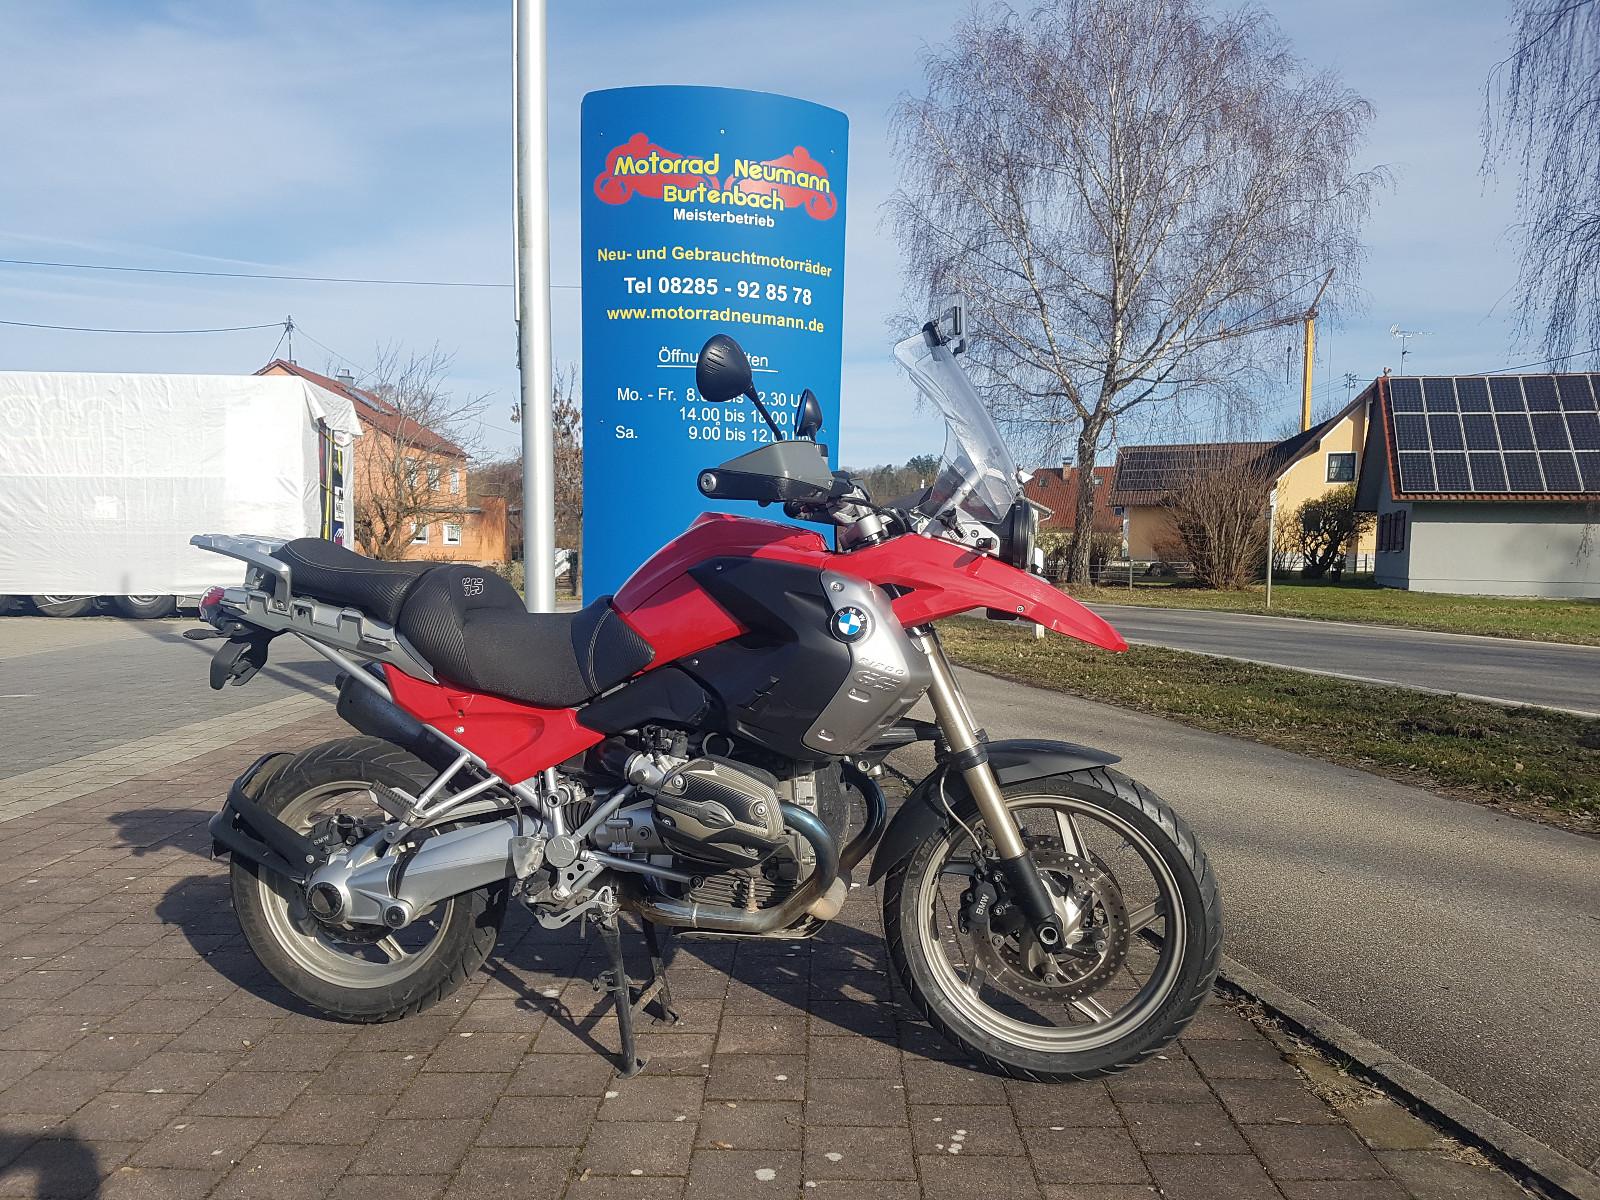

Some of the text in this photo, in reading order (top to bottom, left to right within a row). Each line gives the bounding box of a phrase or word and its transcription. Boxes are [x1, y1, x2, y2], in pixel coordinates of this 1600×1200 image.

[613, 151, 831, 194] Motorrad Neumann
[662, 183, 785, 211] Burtenbach
[672, 207, 775, 228] Meisterbetrieb
[597, 246, 833, 277] Neu- und Gebrauchtmotorräder
[623, 276, 652, 294] Tel
[658, 276, 719, 296] 08285
[737, 280, 761, 299] 92
[765, 283, 789, 303] 85
[792, 286, 813, 307] 78
[606, 305, 824, 331] www.motorradneumann.de
[658, 346, 769, 367] Öffnuten
[617, 387, 643, 401] Mo.
[658, 387, 676, 401] Fr.
[751, 391, 787, 407] 2.30
[679, 406, 720, 421] 14.00
[724, 408, 746, 423] bis
[750, 409, 788, 426] 1800
[615, 425, 638, 440] Sa.
[688, 425, 721, 441] 9.00
[725, 427, 746, 442] bis
[838, 608, 867, 622] BMW
[976, 893, 989, 915] BMW
